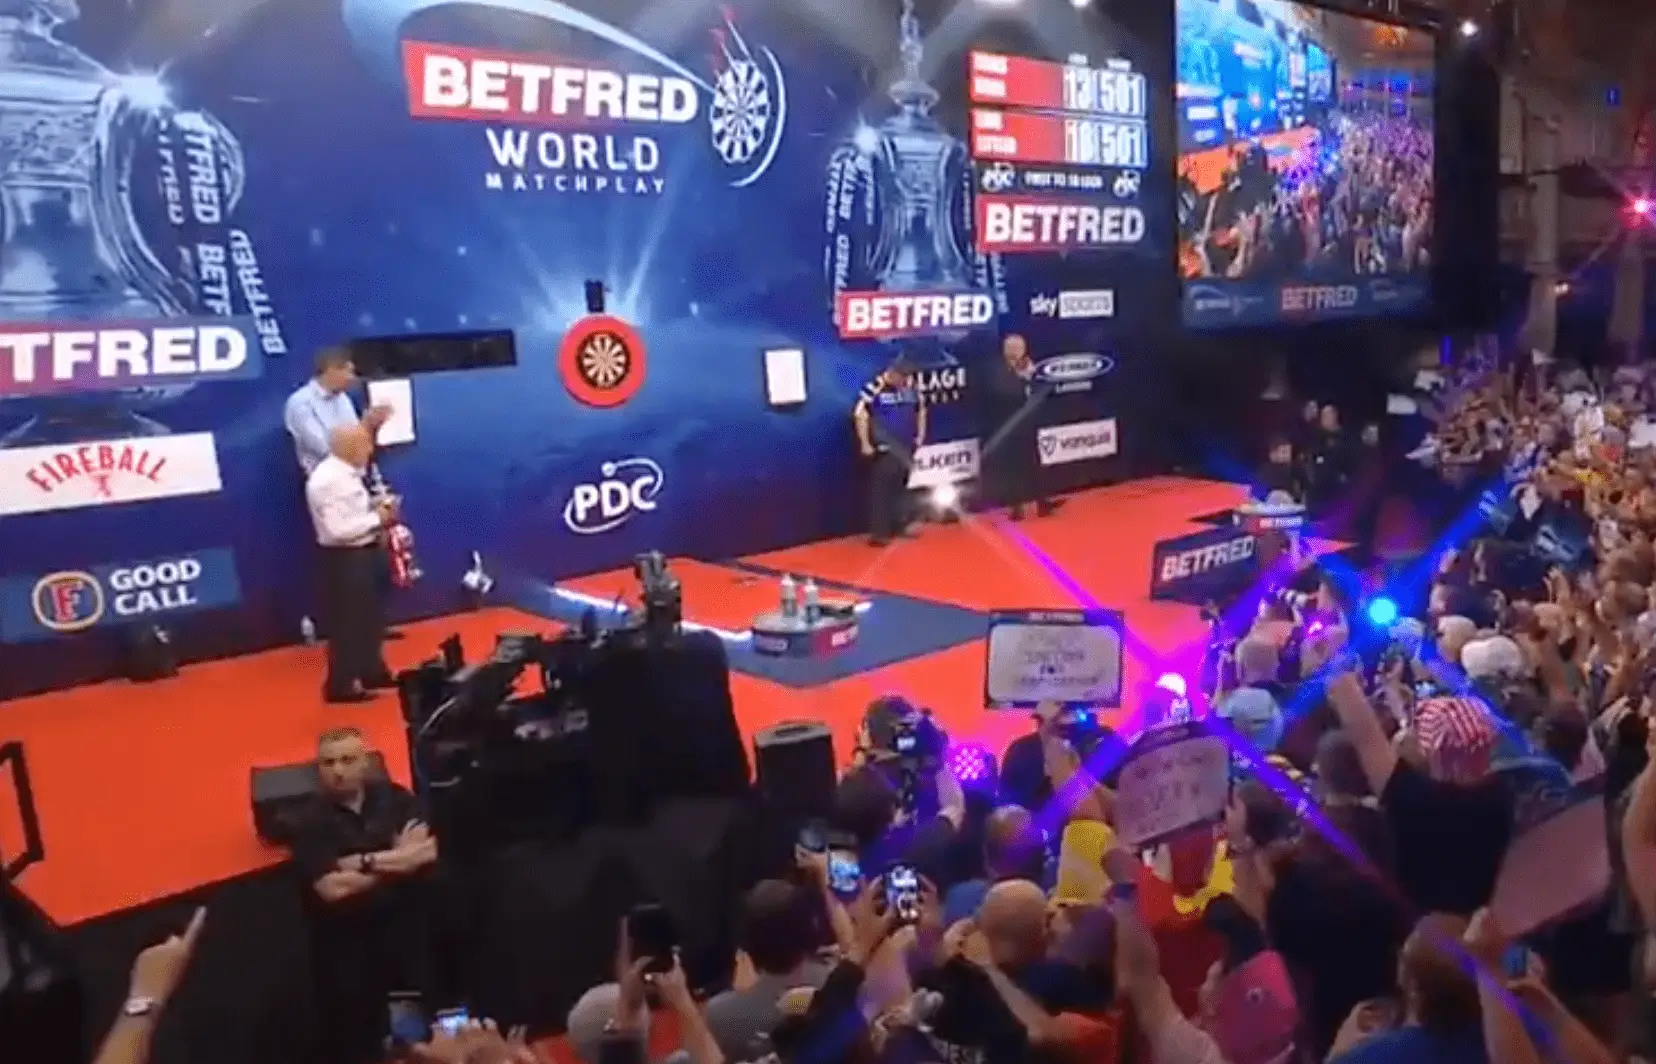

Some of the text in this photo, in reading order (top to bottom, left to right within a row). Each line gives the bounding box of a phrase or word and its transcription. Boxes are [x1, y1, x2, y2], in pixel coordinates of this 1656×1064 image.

[423, 54, 698, 122] BETFRED
[486, 128, 659, 172] WORLD
[485, 173, 665, 194] MATCHPLAY
[984, 203, 1145, 244] BETFRED
[847, 293, 993, 332] BETFRED
[0, 326, 247, 382] TFRED
[26, 443, 166, 492] FIREBALL
[574, 475, 657, 522] PDC
[110, 558, 201, 591] GOOD
[1161, 535, 1256, 582] BETFRED
[115, 584, 198, 615] CALL
